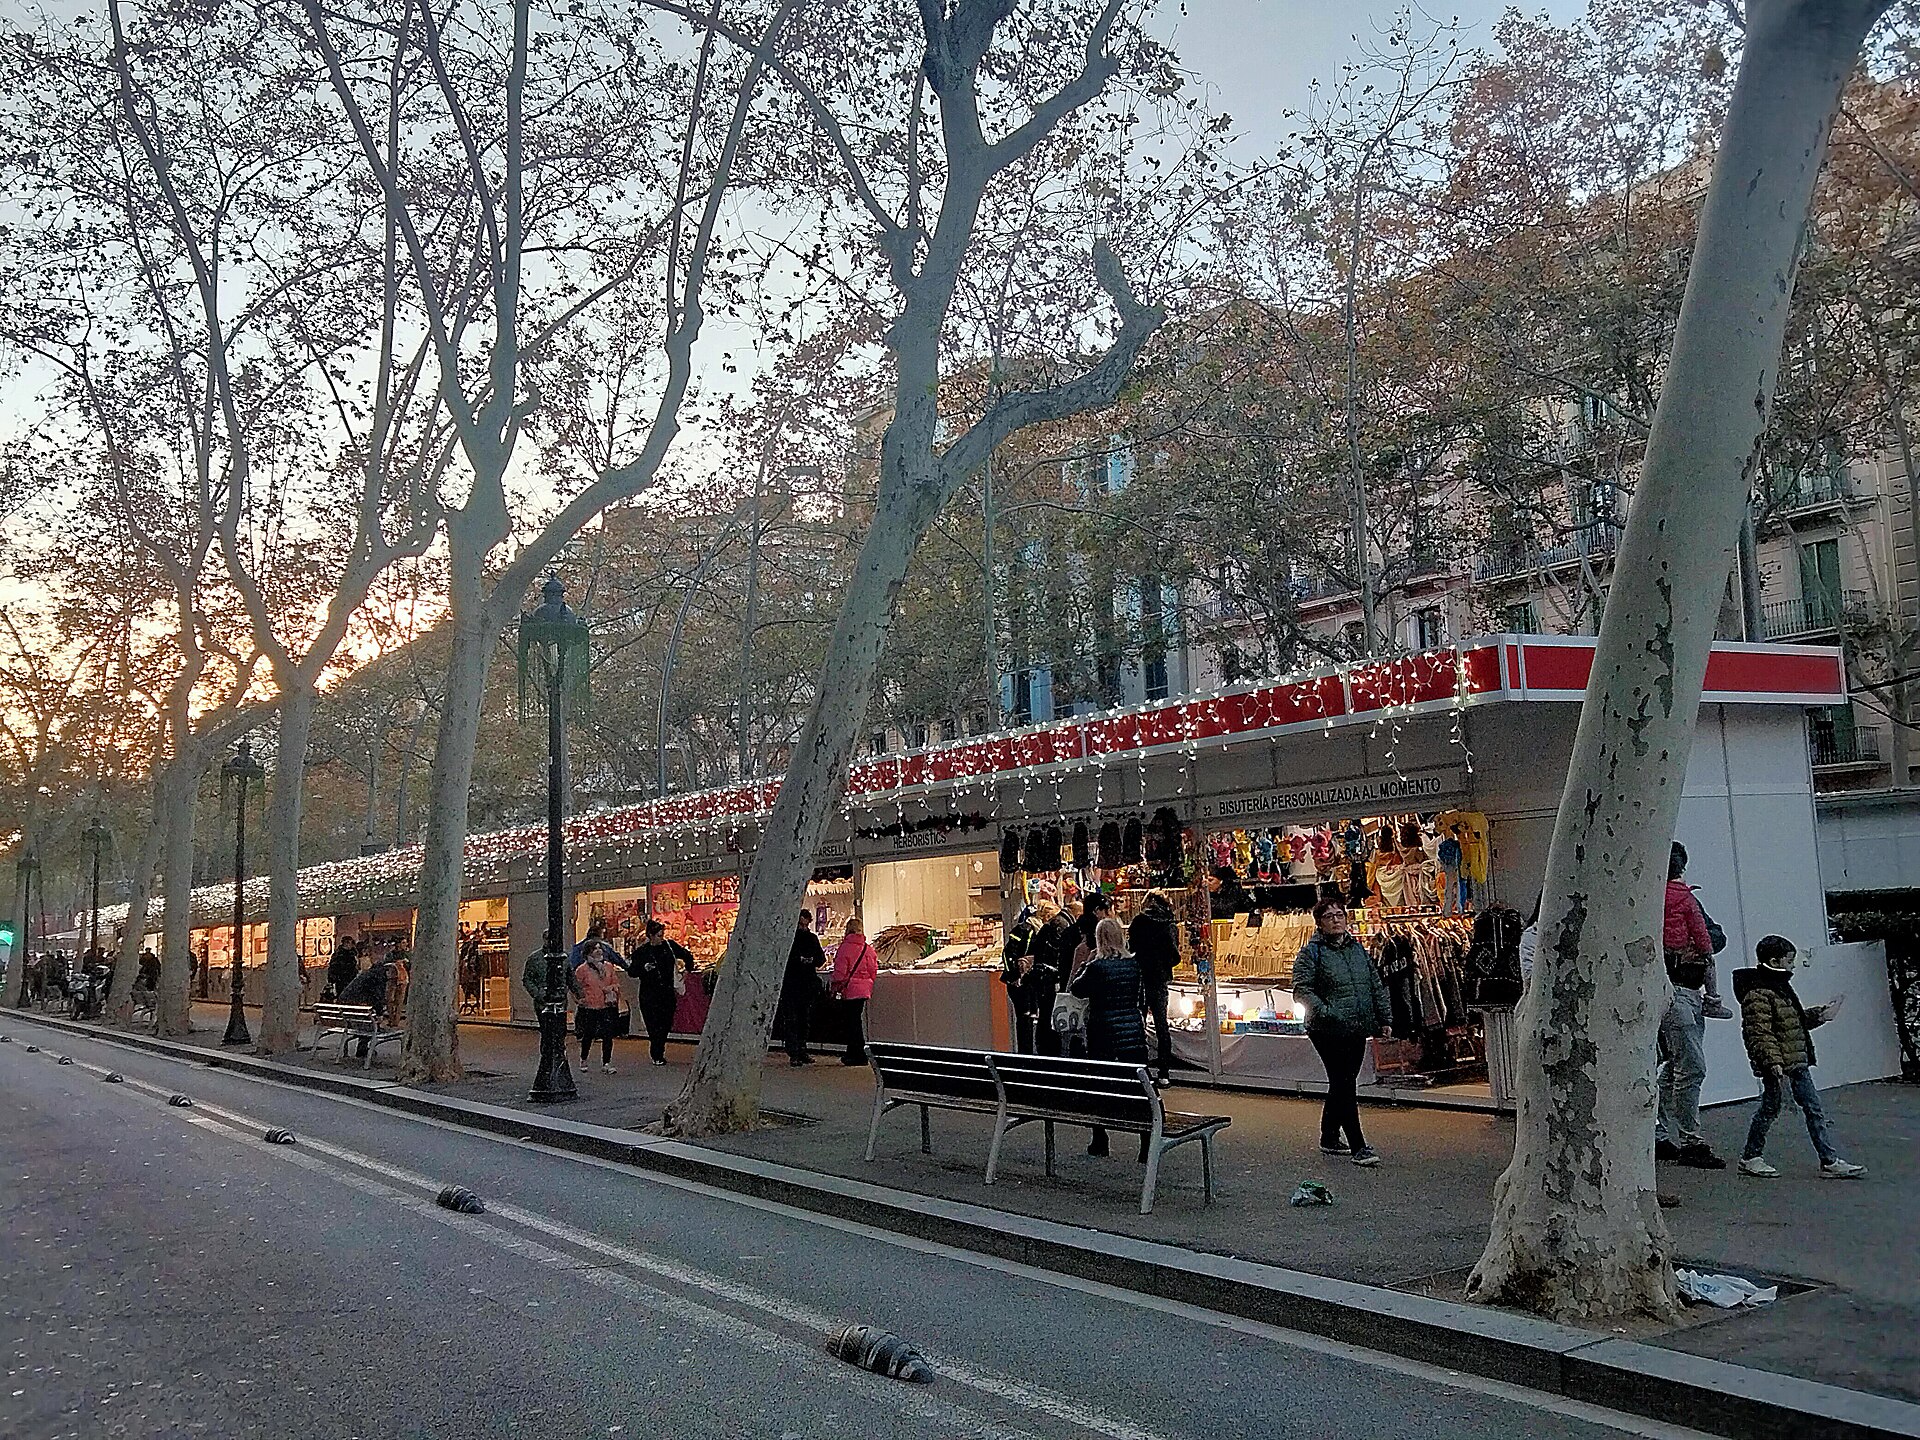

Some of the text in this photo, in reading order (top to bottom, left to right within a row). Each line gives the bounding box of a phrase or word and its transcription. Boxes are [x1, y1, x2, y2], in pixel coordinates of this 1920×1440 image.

[1219, 794, 1270, 815] BISUTERÍA
[1271, 786, 1360, 810] PERSONALIZADA
[1362, 785, 1378, 799] AL
[1379, 777, 1441, 797] MOMENTO
